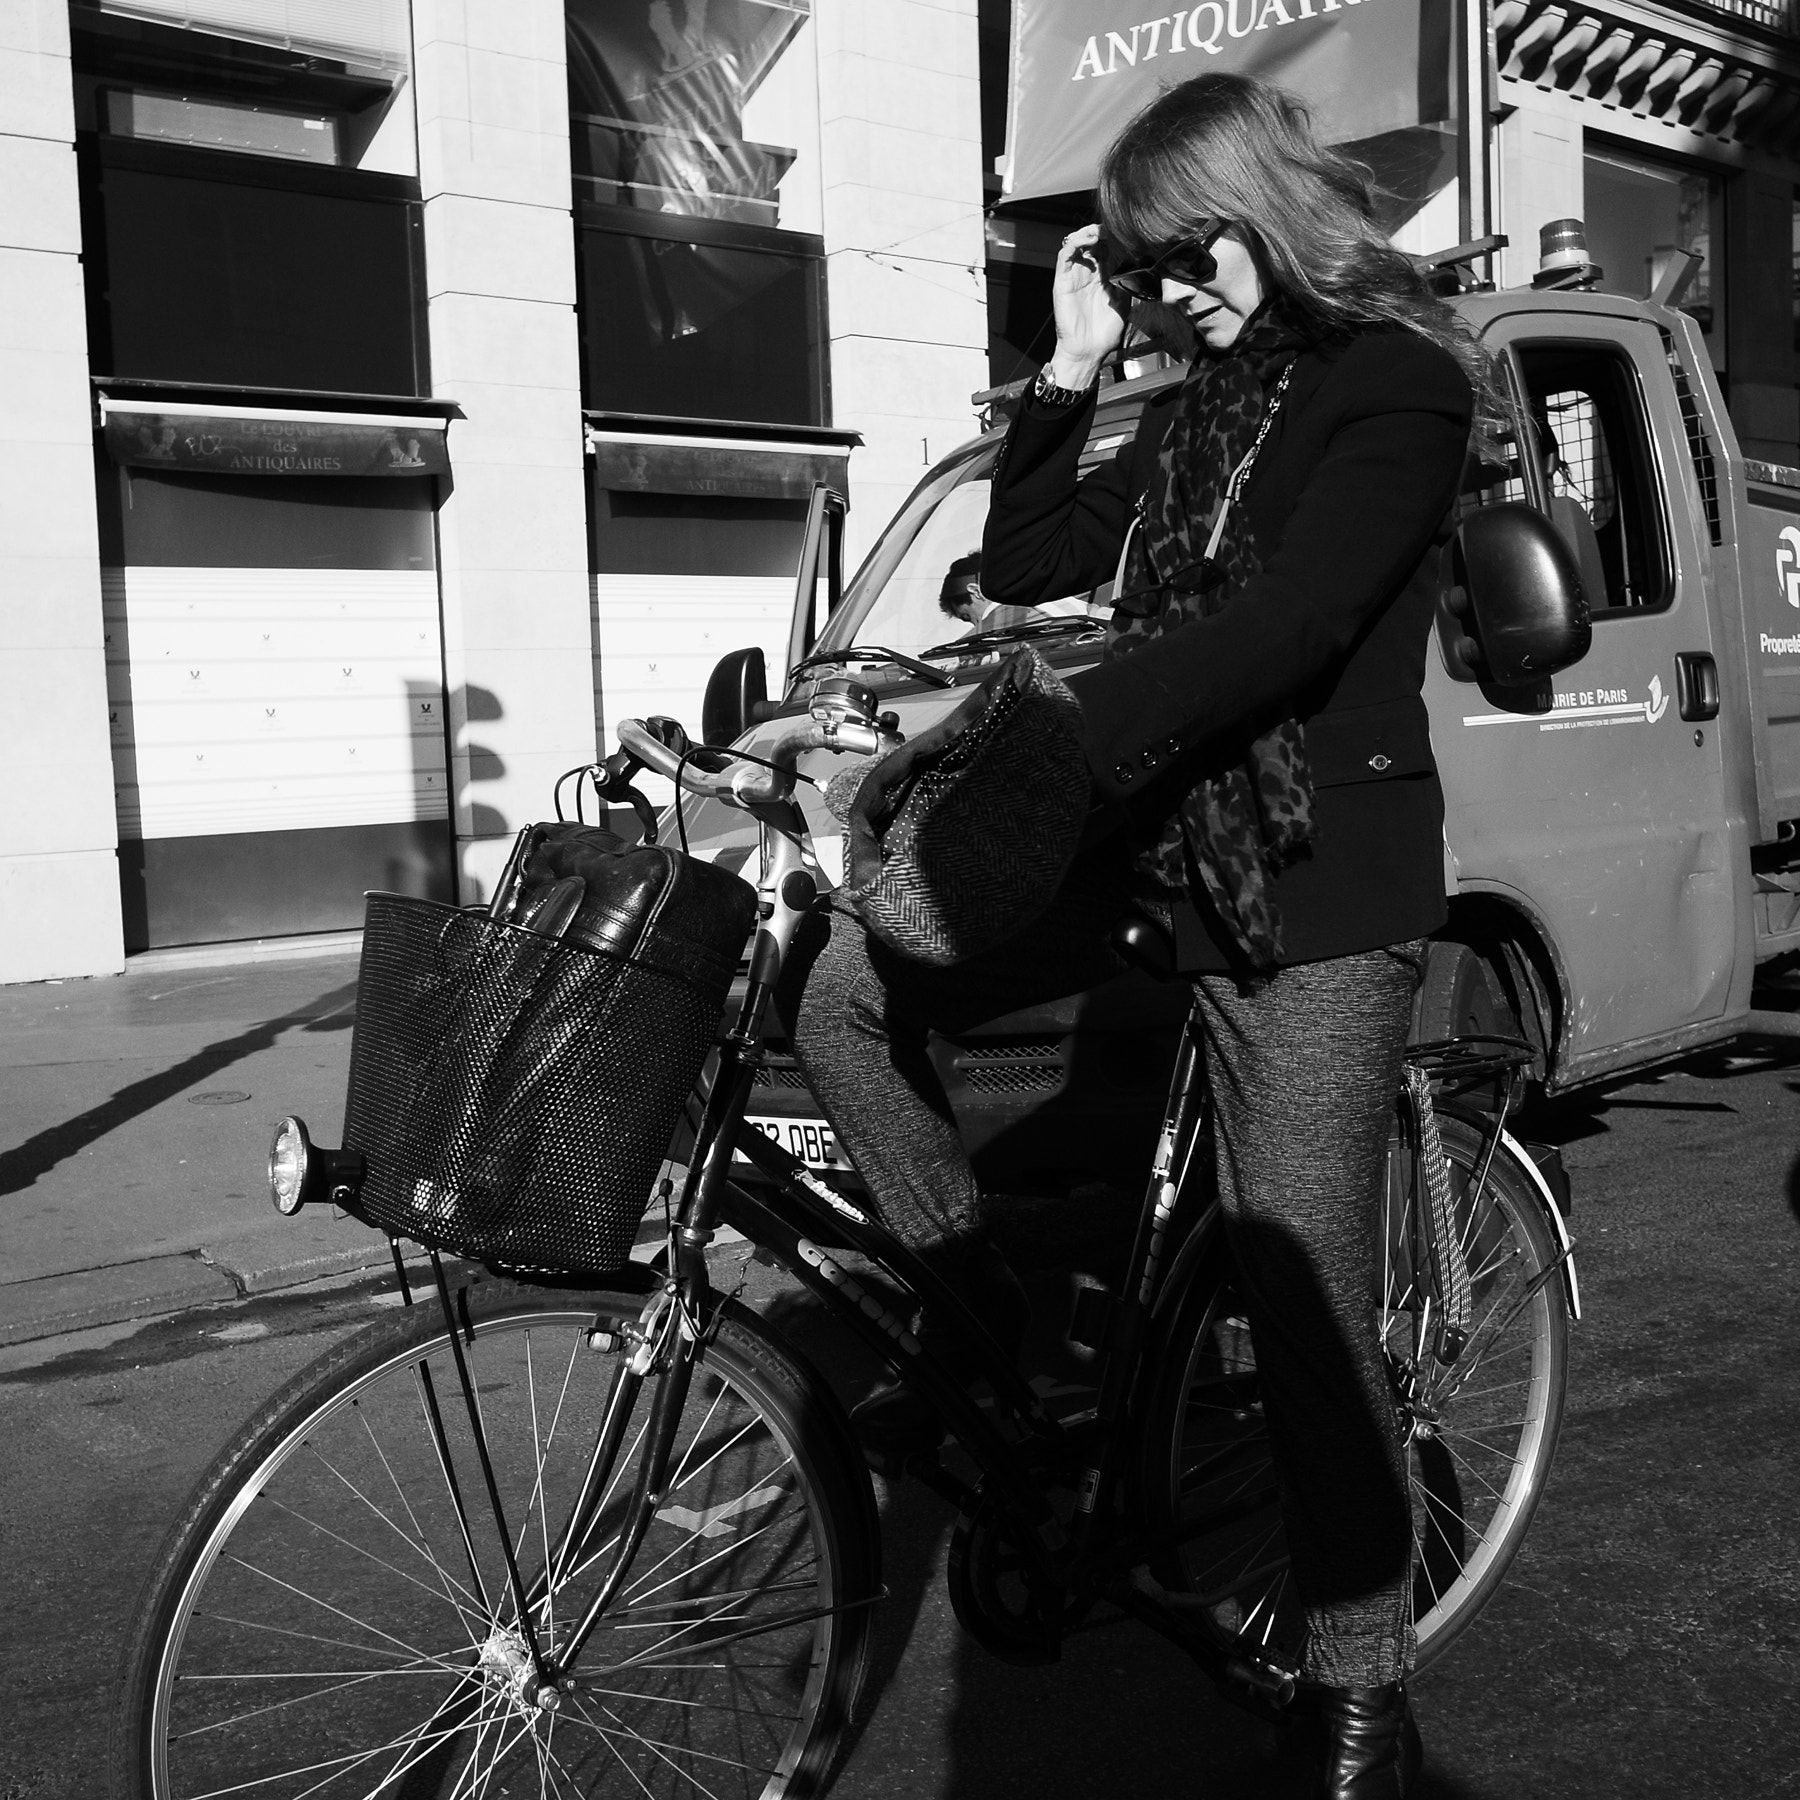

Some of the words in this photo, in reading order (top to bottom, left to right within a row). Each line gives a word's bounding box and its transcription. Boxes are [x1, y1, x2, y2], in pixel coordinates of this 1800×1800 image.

[1072, 0, 1372, 80] ANTIQUA
[273, 439, 298, 453] des
[230, 455, 341, 473] ANTIQUAIRES
[1537, 692, 1578, 708] MAIRIE
[1579, 691, 1595, 706] DE
[1596, 688, 1628, 704] PARIS
